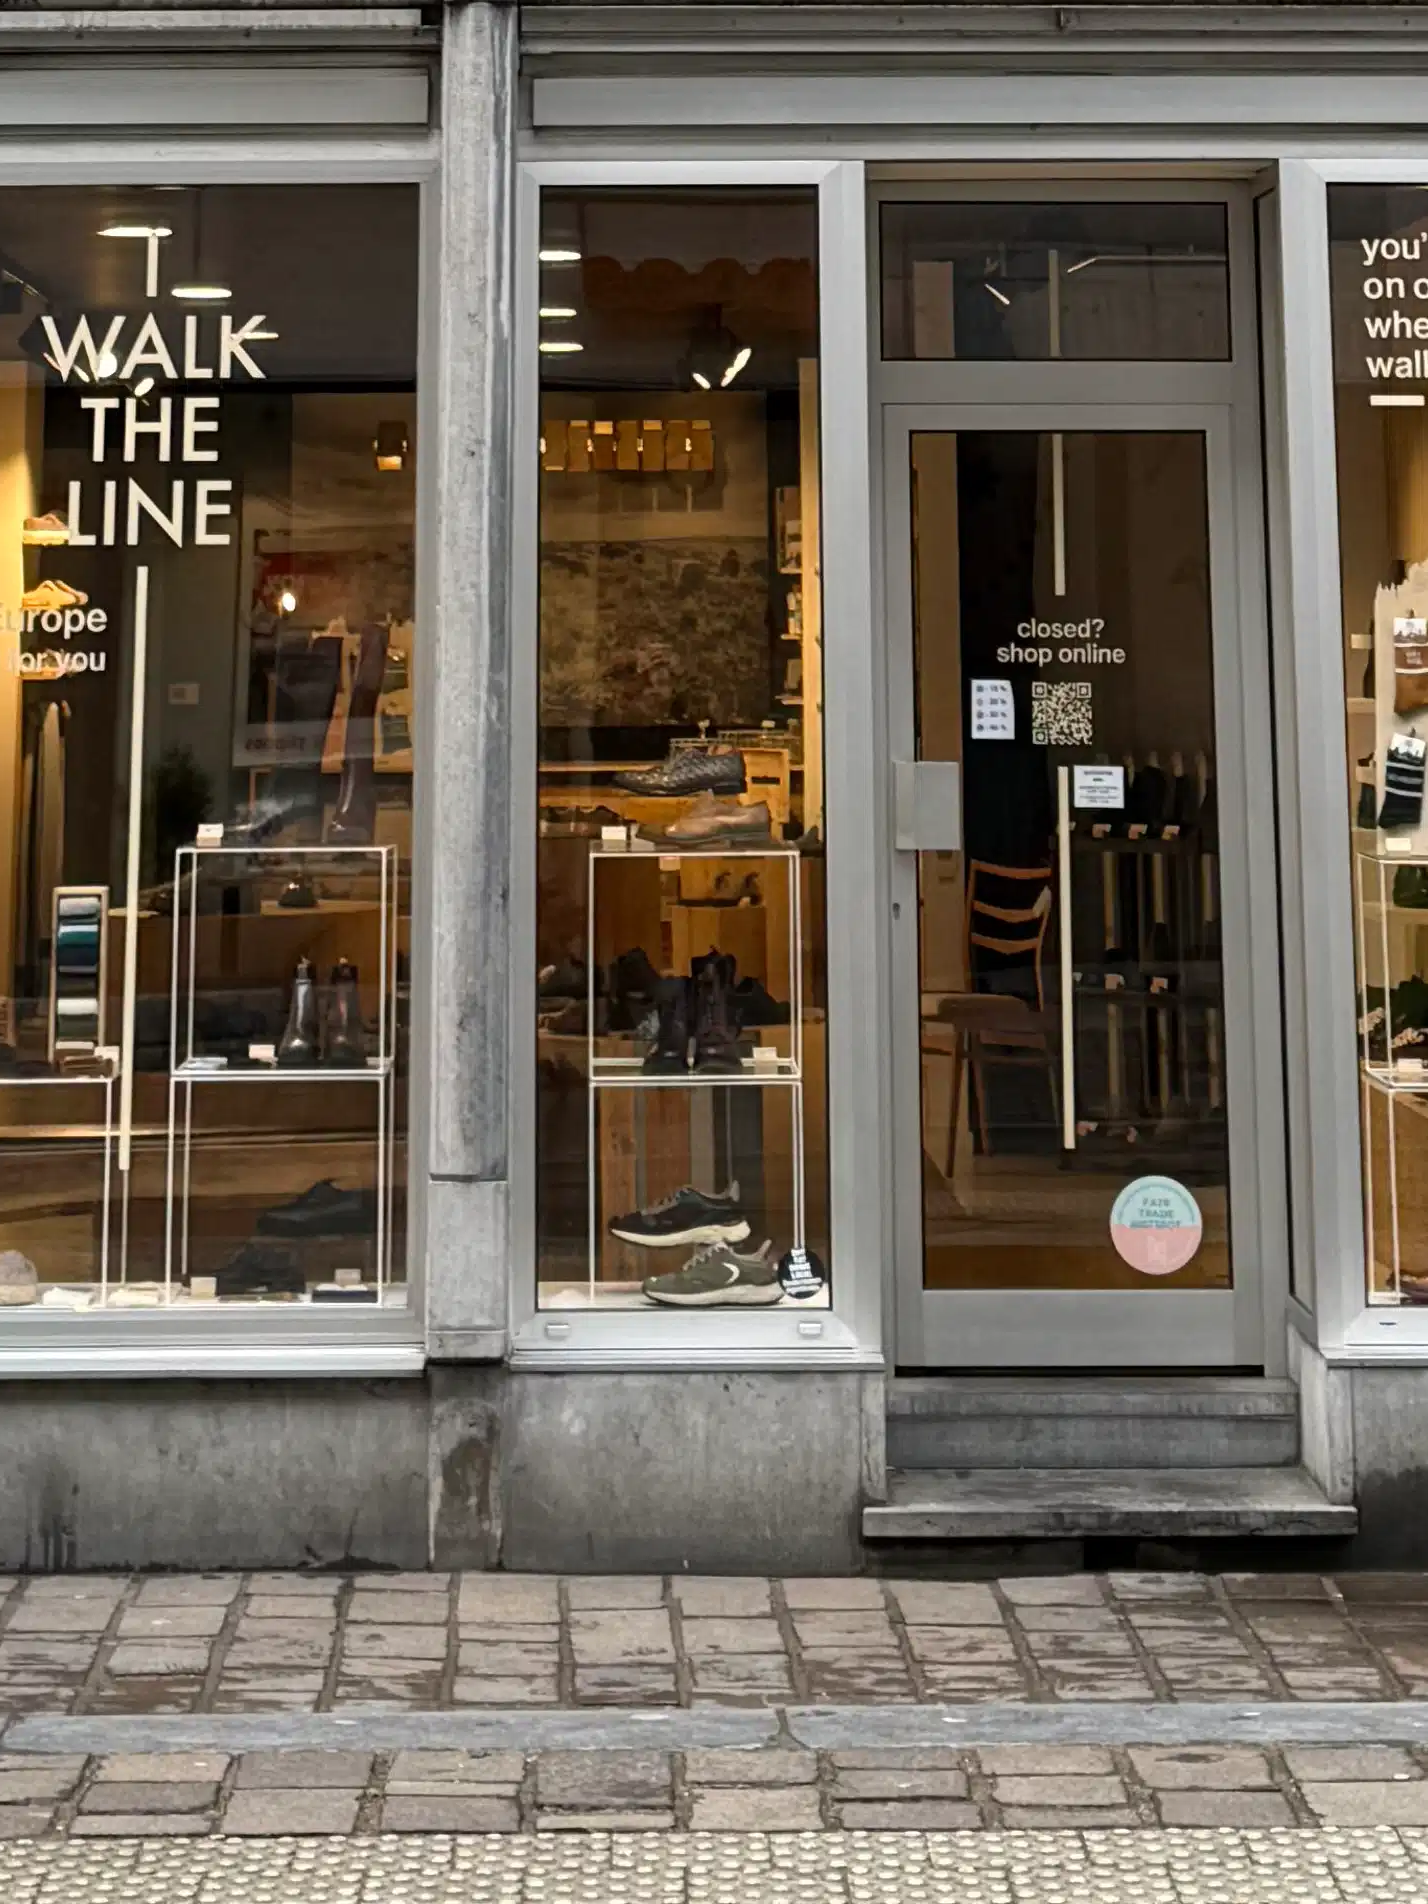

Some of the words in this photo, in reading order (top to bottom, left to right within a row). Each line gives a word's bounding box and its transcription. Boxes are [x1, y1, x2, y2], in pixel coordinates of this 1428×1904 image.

[1363, 276, 1406, 300] on
[41, 312, 267, 380] WALK
[80, 397, 220, 463] THE
[67, 477, 233, 549] LINE
[1016, 617, 1105, 639] closed?
[53, 650, 107, 679] you
[995, 643, 1054, 667] shop
[1058, 643, 1127, 664] online
